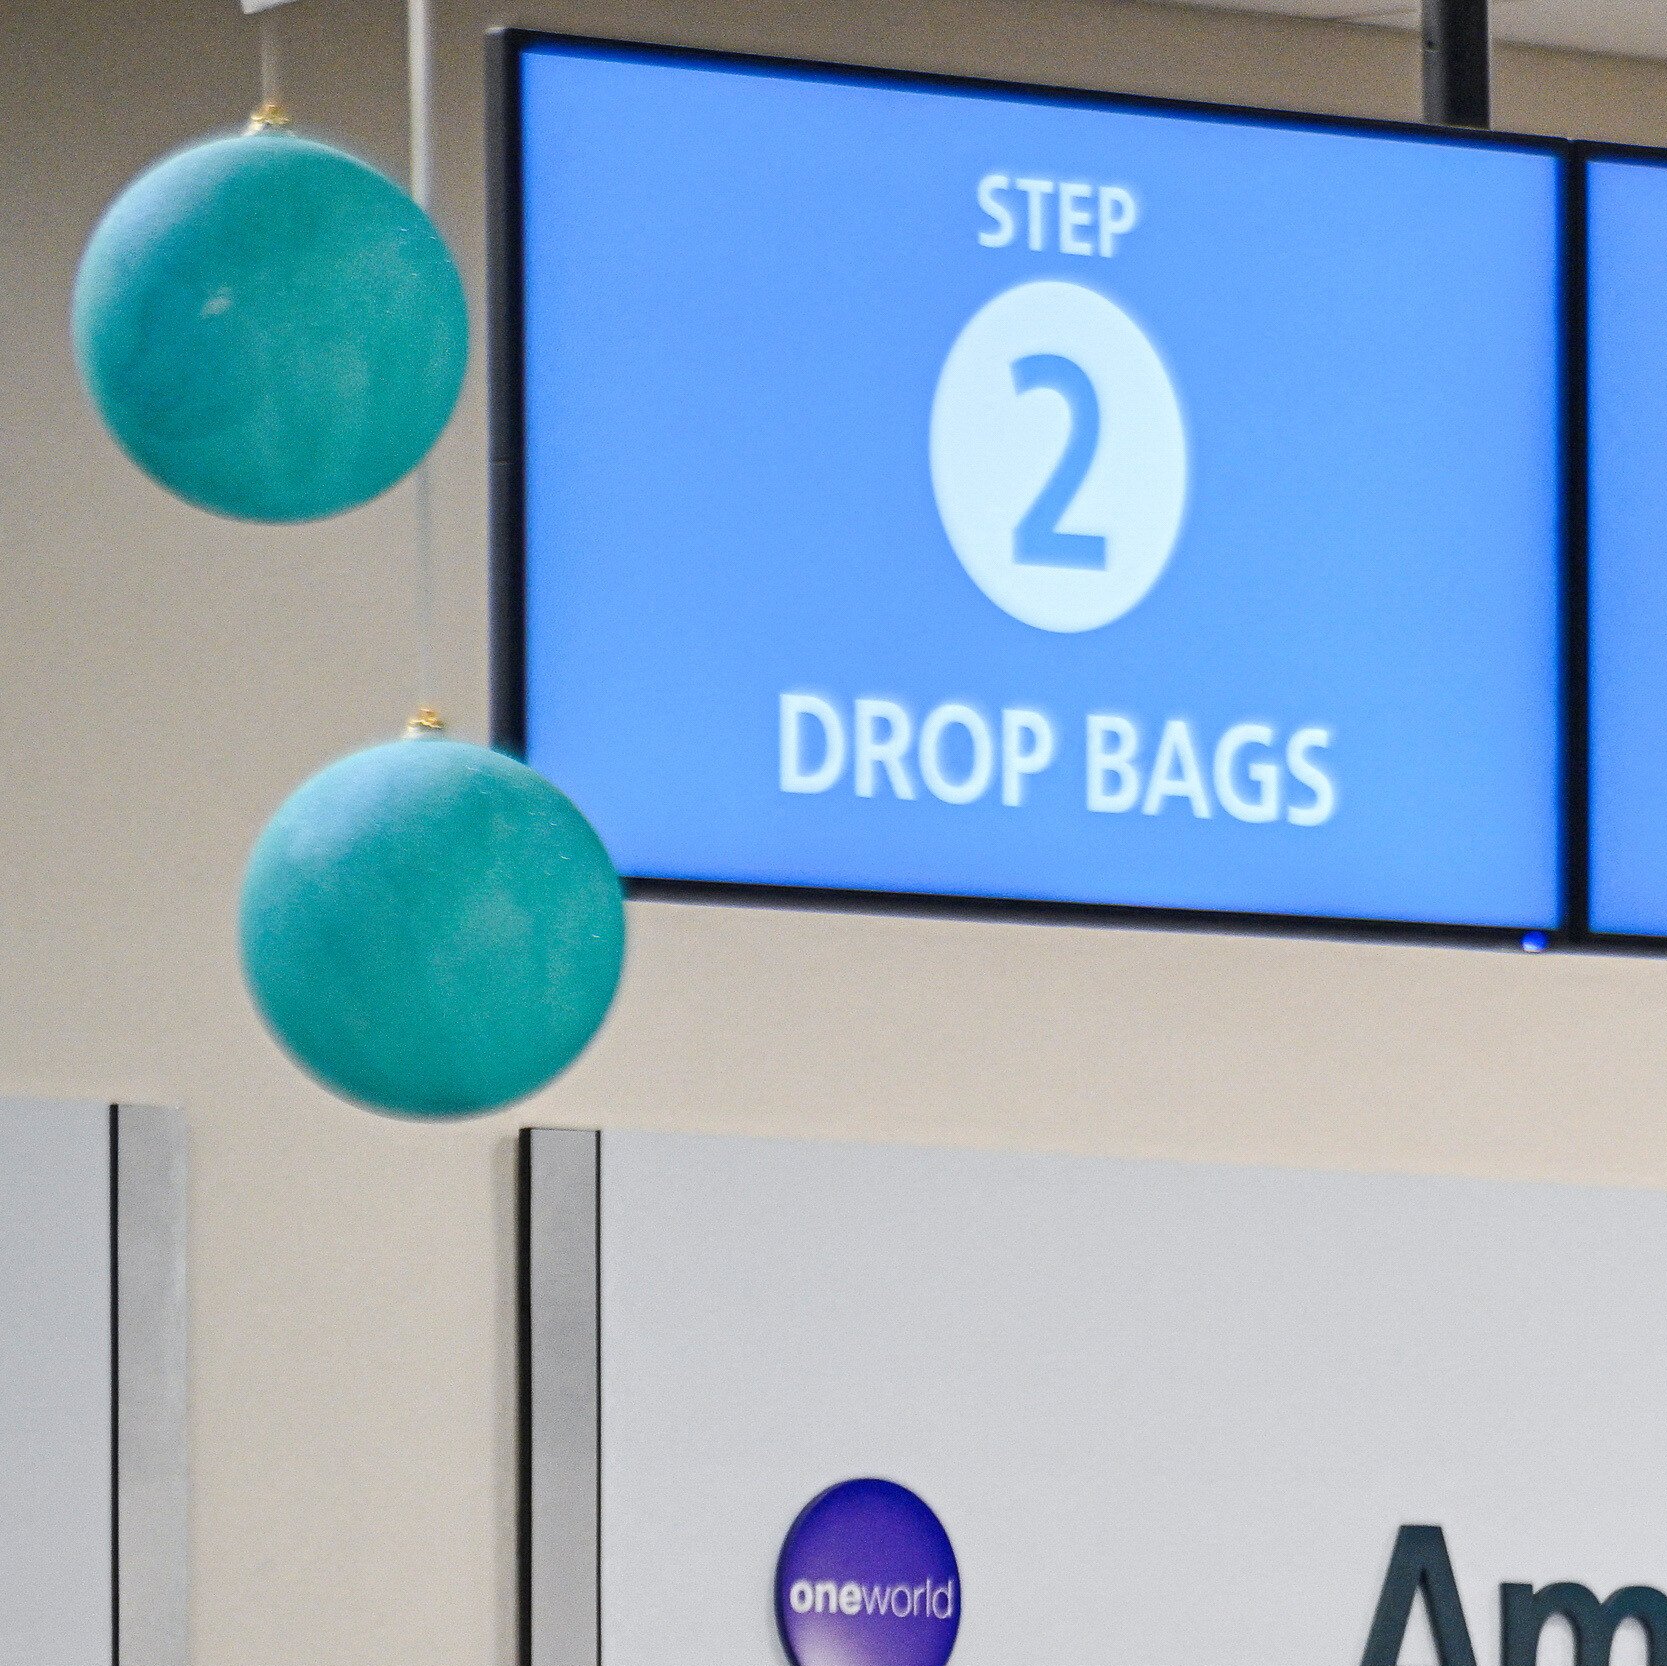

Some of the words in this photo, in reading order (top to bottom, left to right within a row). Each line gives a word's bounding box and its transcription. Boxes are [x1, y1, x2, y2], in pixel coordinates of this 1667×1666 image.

[978, 173, 1138, 257] STEP
[1012, 353, 1107, 569] 2
[781, 692, 1056, 806] DROP
[1087, 713, 1336, 825] BAGS
[789, 1578, 953, 1618] oneworld
